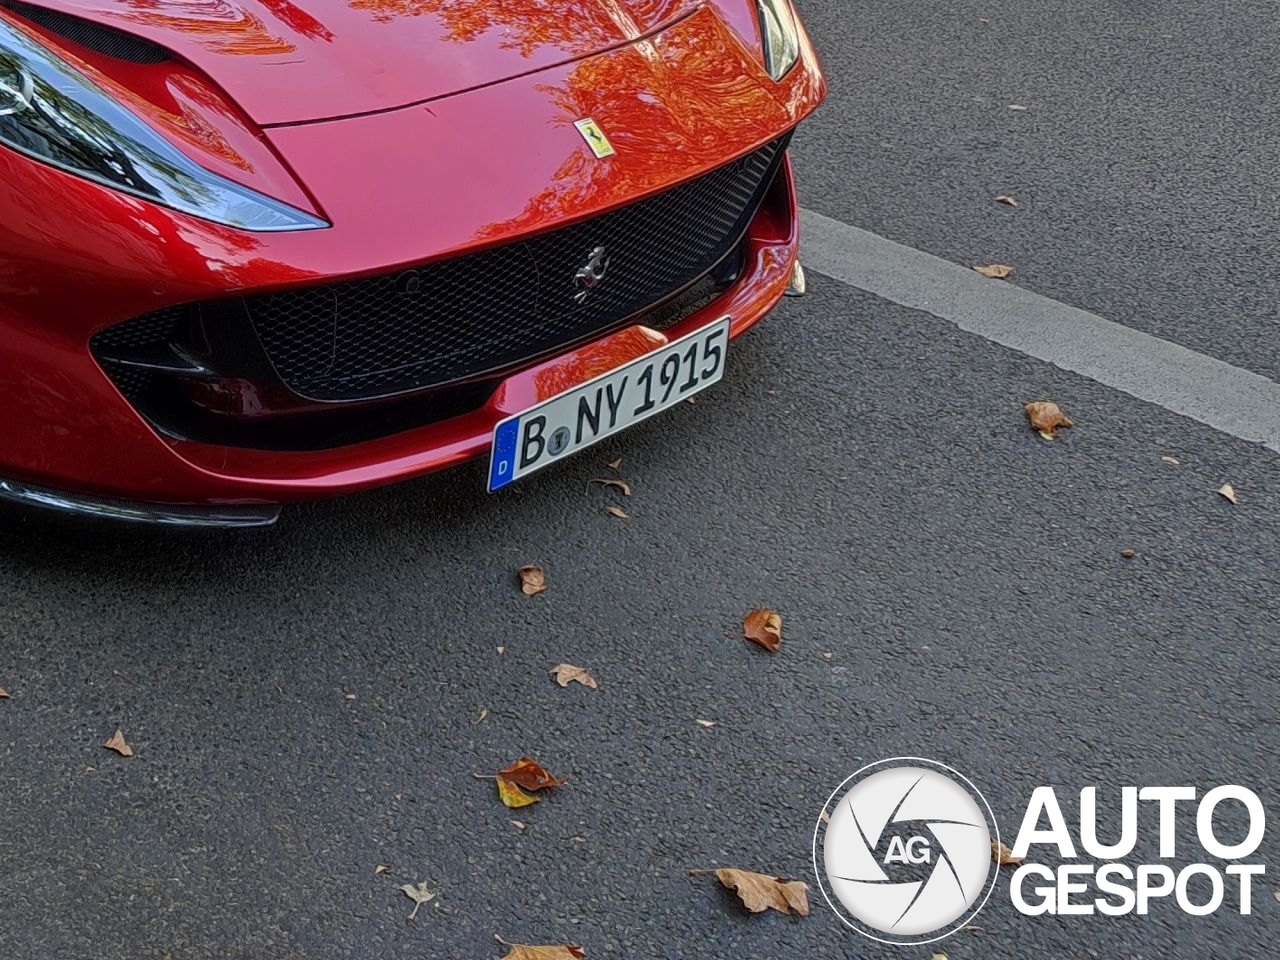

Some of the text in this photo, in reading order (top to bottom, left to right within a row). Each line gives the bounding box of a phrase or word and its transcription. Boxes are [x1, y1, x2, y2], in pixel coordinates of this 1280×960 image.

[519, 327, 725, 470] B NY 1915
[497, 459, 508, 476] D
